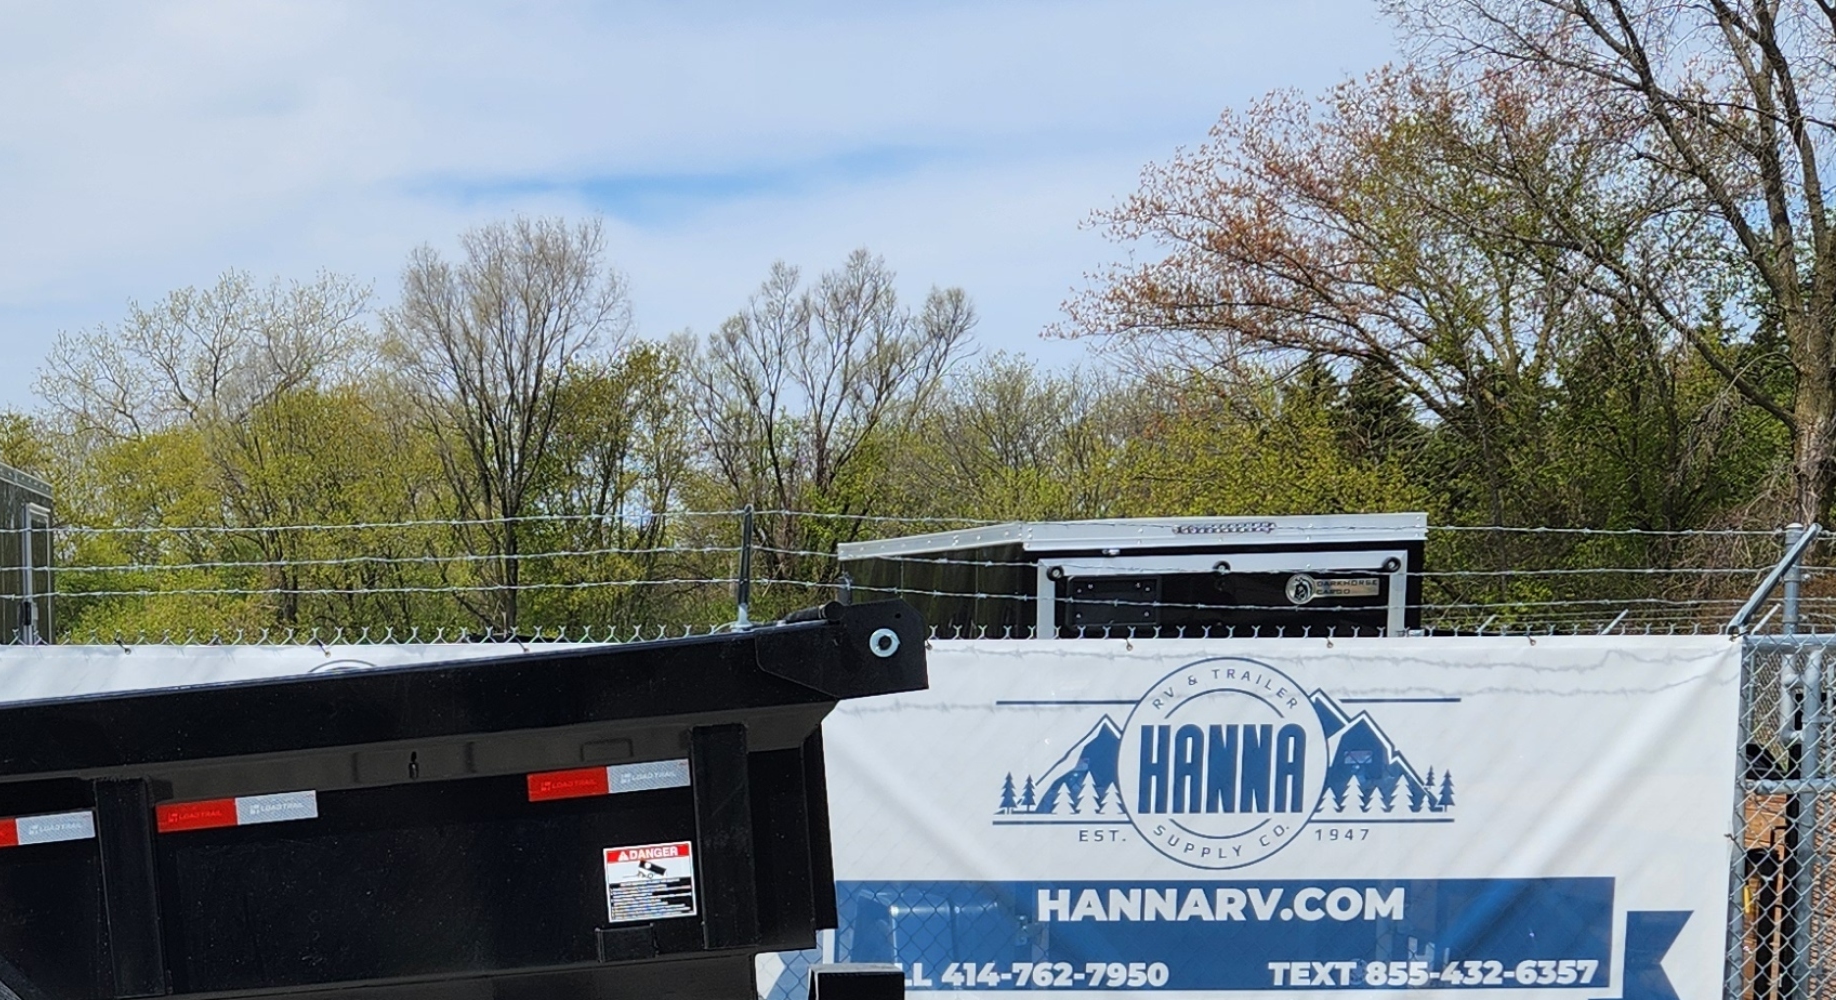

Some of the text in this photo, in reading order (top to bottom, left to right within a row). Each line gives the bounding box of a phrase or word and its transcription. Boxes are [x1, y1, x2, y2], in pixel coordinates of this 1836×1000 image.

[1152, 687, 1176, 710] RV
[1211, 668, 1298, 709] TRAILER
[1137, 723, 1307, 814] HANNA
[1079, 830, 1126, 842] EST.
[1153, 824, 1290, 859] SUPPLY CO.
[1315, 829, 1370, 841] 1947
[629, 846, 679, 860] DANGER
[1037, 887, 1405, 921] HANNARV.COM
[941, 962, 1170, 987] 414-762-7950
[1268, 959, 1599, 987] TEXT 855-432-6357
